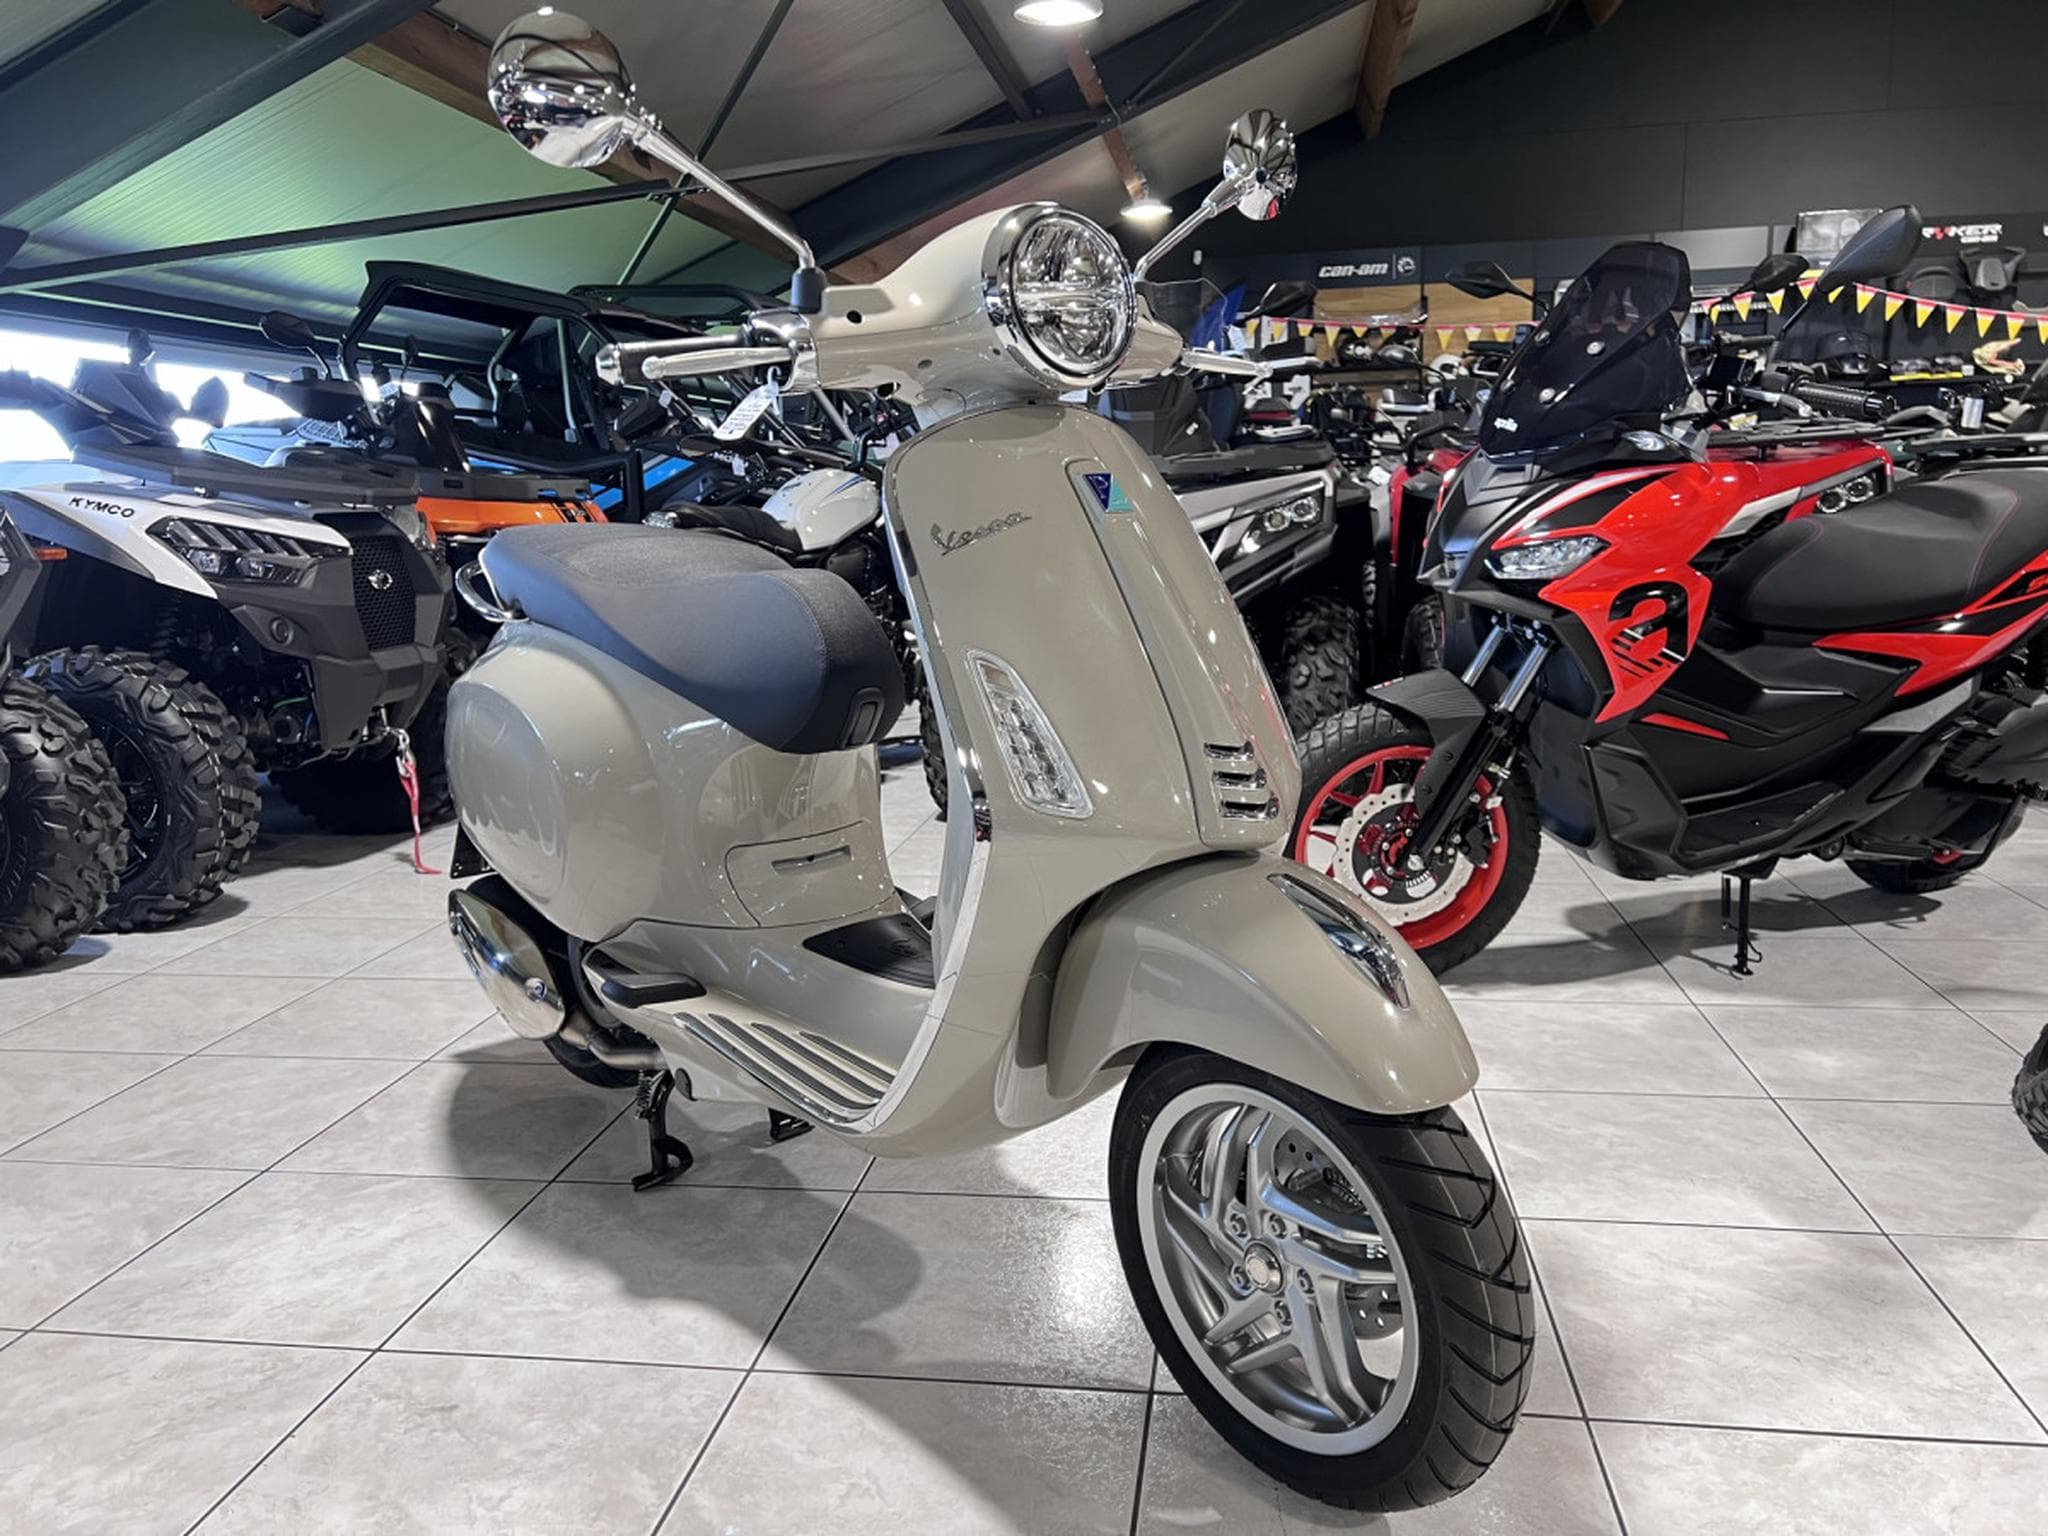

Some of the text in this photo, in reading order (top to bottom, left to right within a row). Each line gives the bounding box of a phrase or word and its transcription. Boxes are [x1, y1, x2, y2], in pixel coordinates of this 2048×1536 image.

[1318, 262, 1388, 278] can-am
[68, 496, 135, 518] KYMCO
[930, 511, 1033, 557] Vespa
